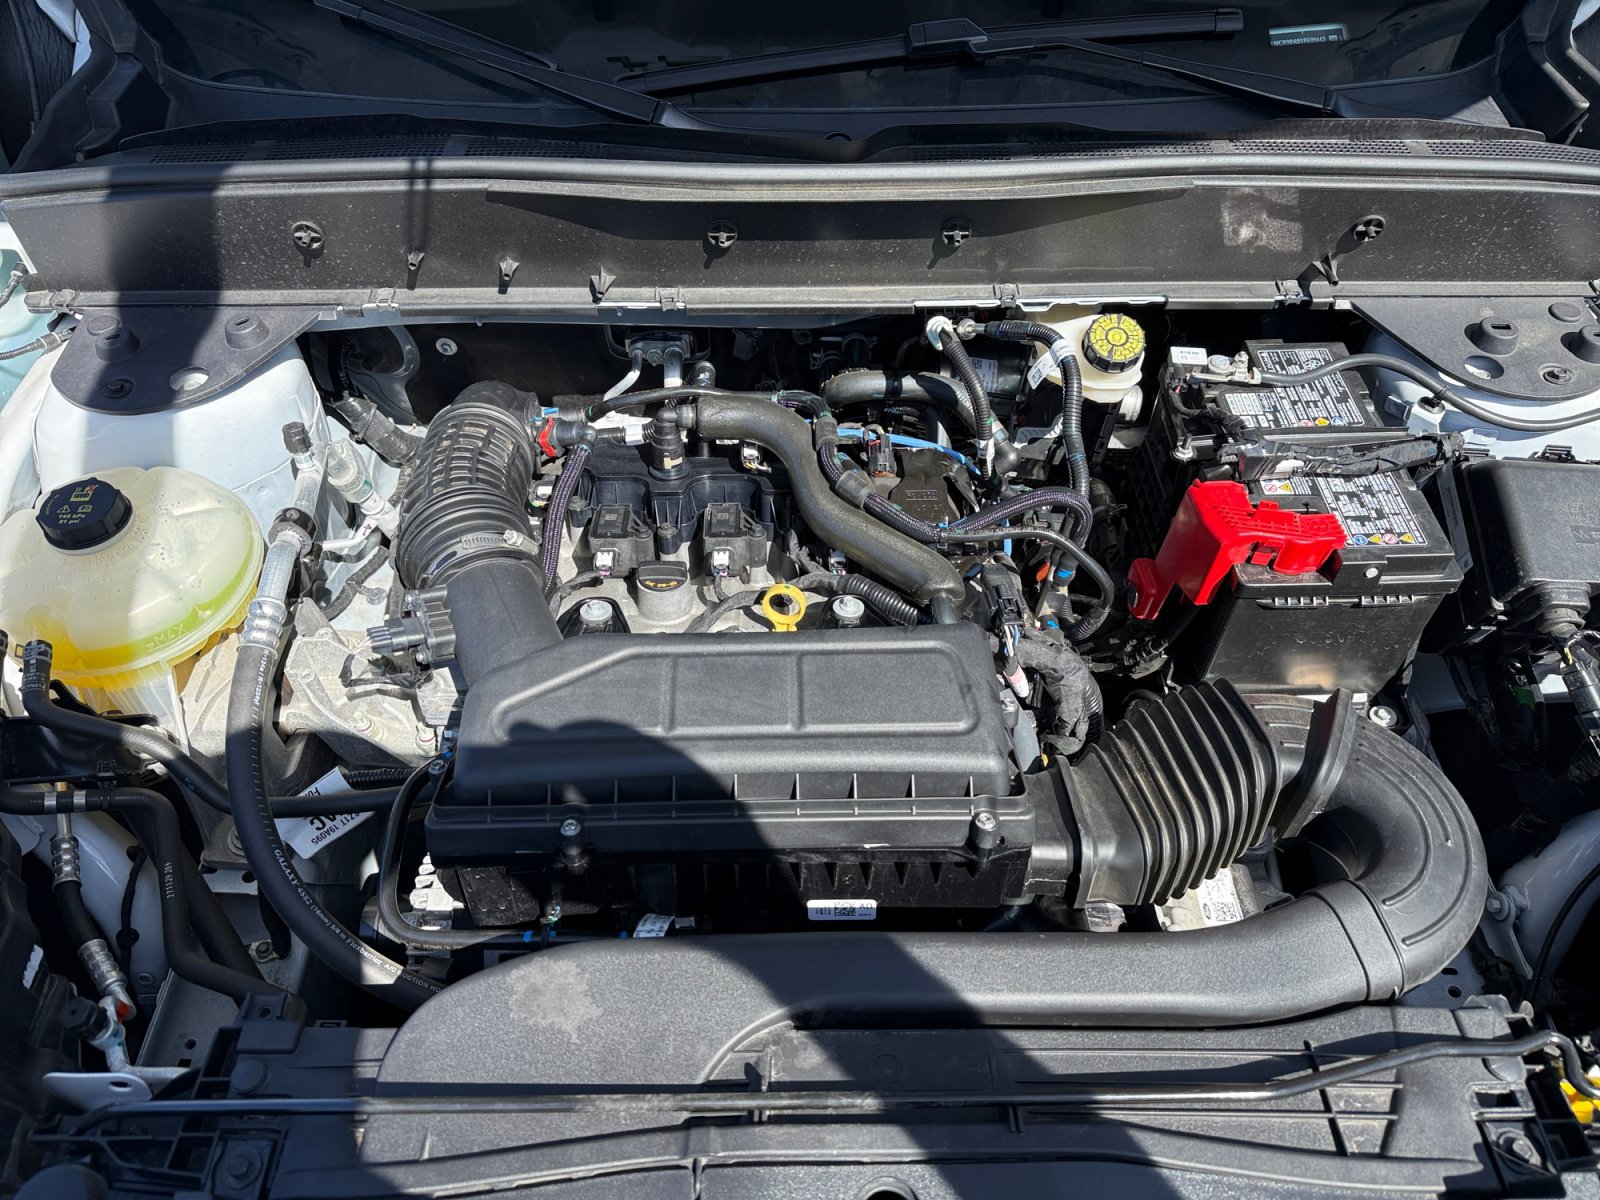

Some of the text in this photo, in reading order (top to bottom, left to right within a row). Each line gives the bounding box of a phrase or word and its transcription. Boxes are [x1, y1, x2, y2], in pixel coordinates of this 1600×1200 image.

[311, 823, 339, 846] 19A095
[274, 848, 300, 886] GALAXY
[310, 904, 332, 926] (16mm)
[383, 962, 397, 973] A/C
